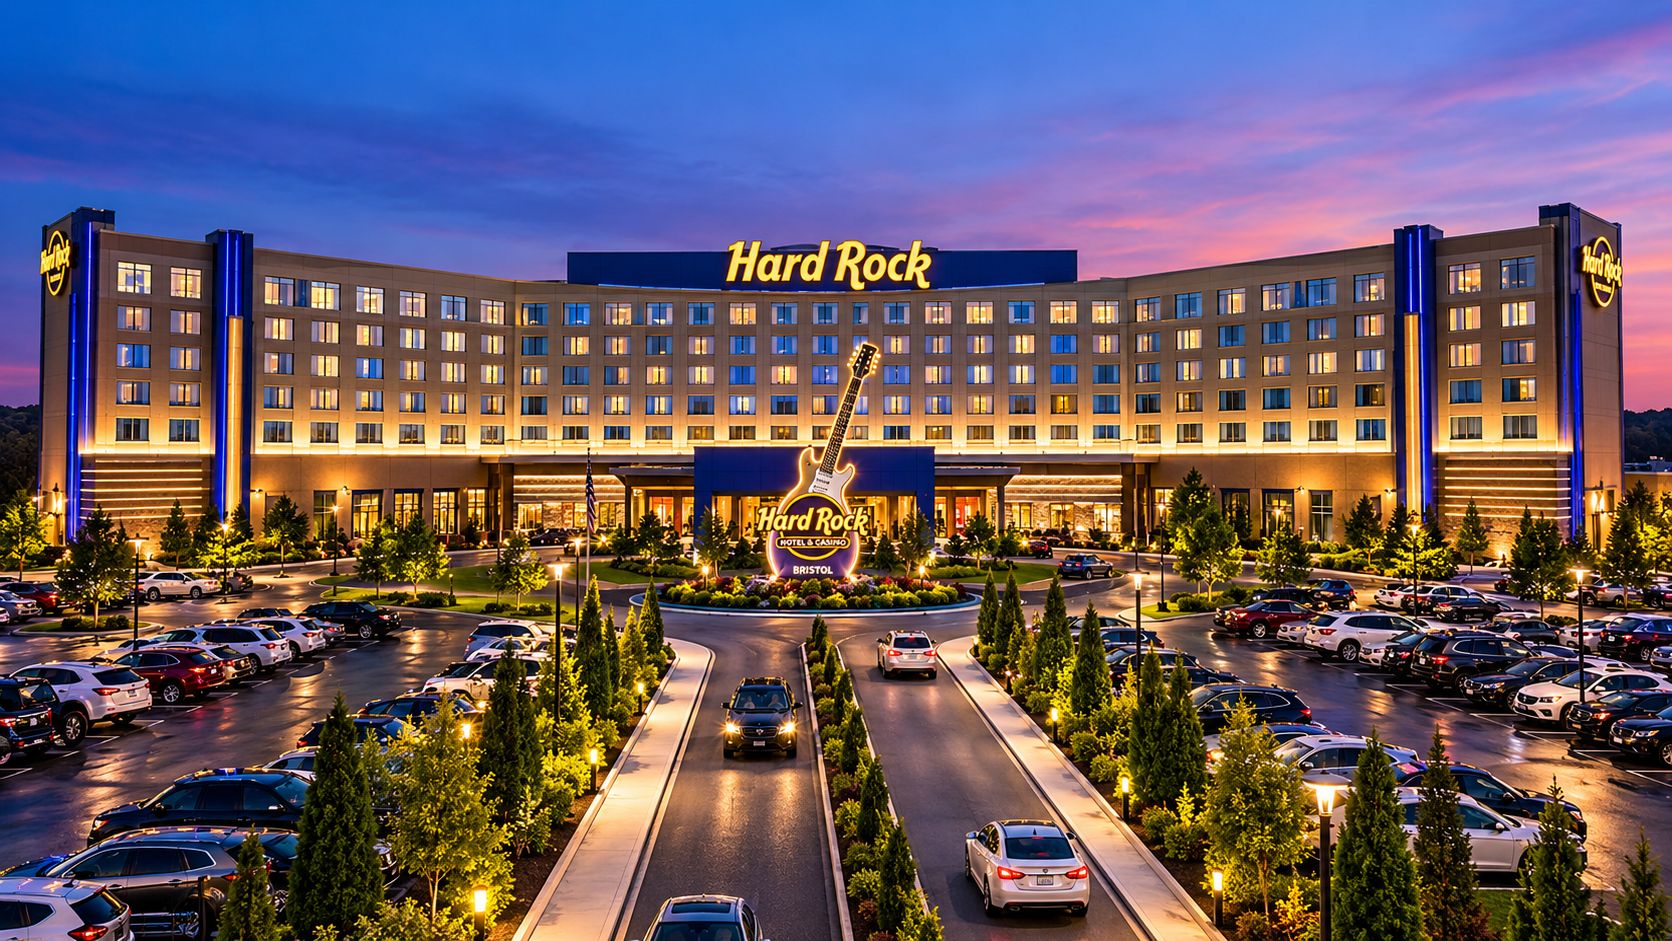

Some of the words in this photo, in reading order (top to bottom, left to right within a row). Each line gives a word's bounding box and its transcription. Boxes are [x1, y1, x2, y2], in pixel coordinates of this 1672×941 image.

[726, 240, 831, 282] Hard
[834, 240, 932, 290] Rock
[1582, 245, 1605, 277] Hard
[1604, 253, 1622, 287] Rock
[757, 506, 815, 531] Hard
[815, 506, 869, 536] Rock
[793, 565, 834, 575] BRISTOL
